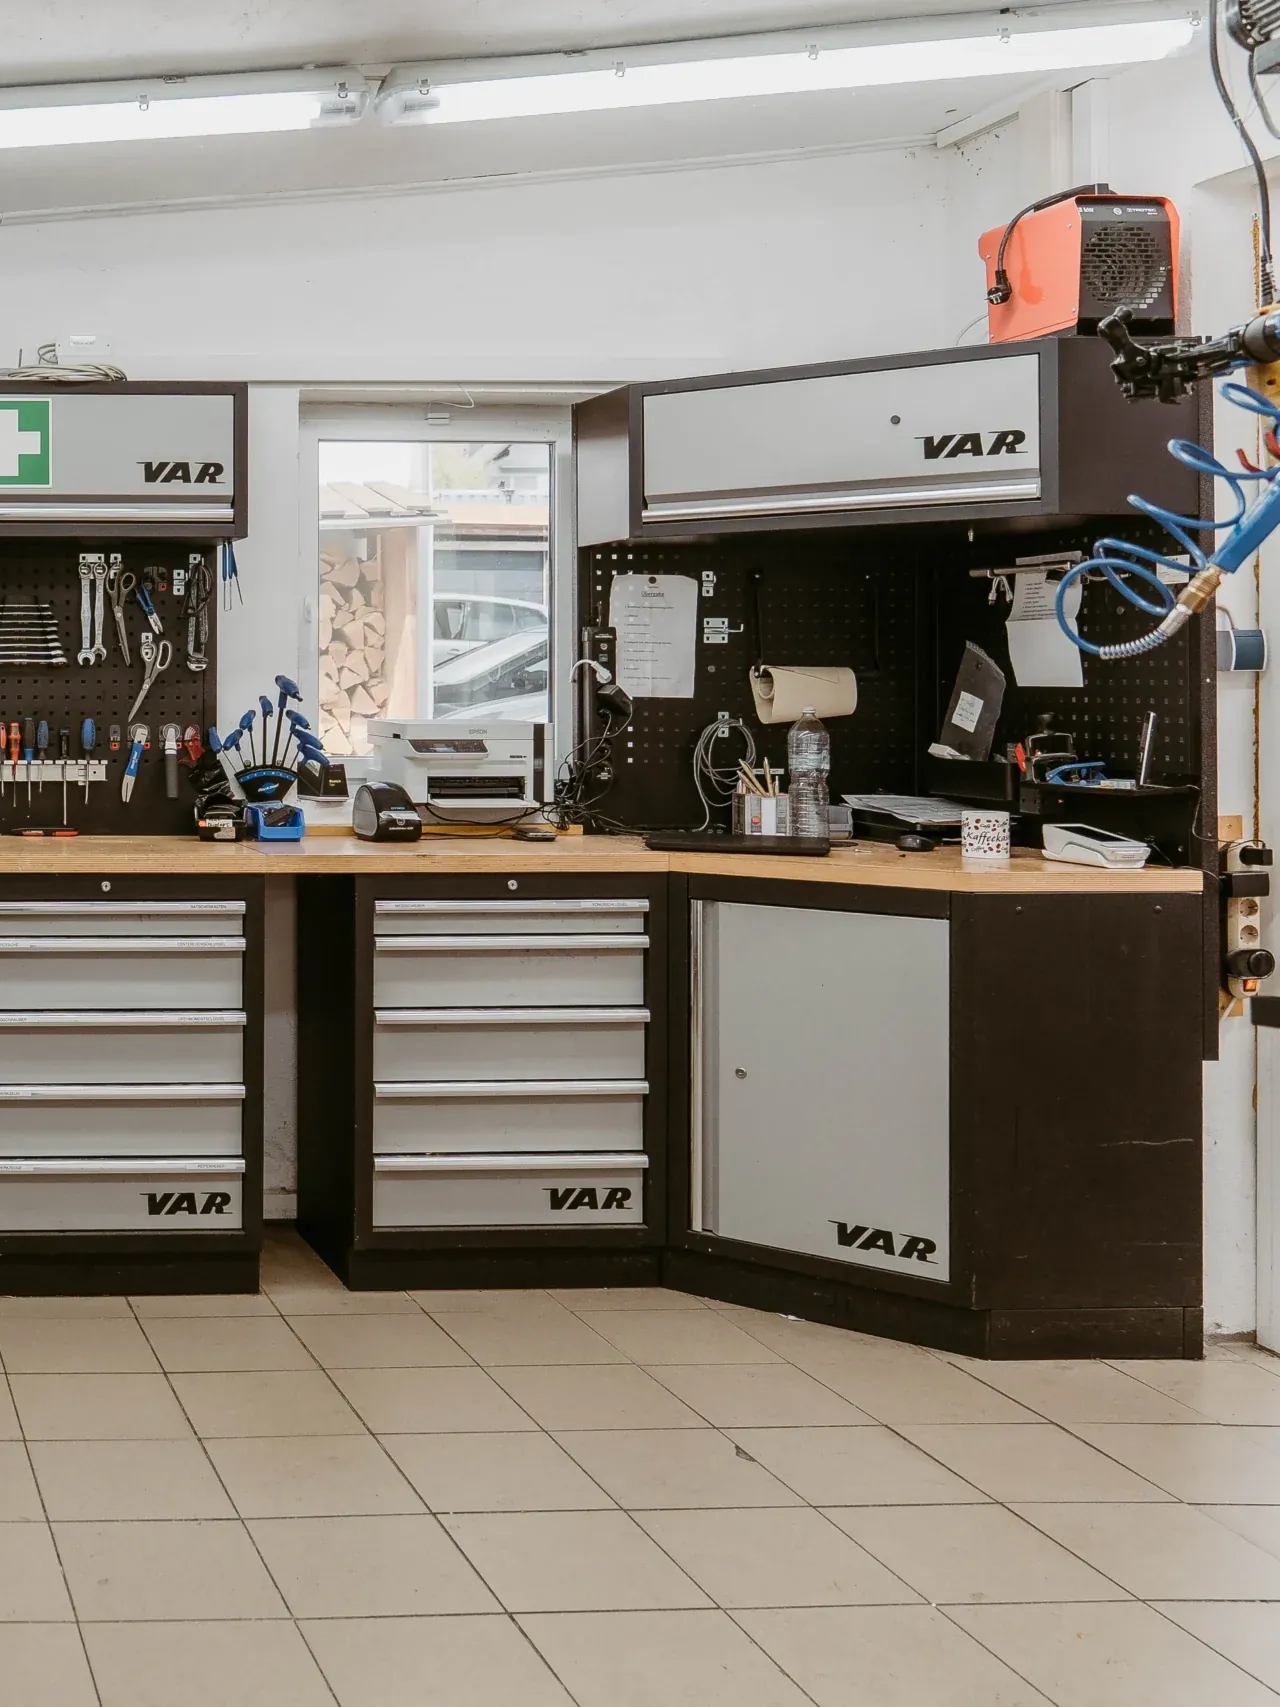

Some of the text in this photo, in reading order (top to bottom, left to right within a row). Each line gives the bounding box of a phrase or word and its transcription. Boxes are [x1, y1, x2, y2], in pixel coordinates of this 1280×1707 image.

[915, 430, 1027, 460] VAR
[137, 461, 225, 484] VAR
[140, 1191, 233, 1216] VAR
[542, 1187, 633, 1211] VAR
[827, 1219, 939, 1265] VAR
